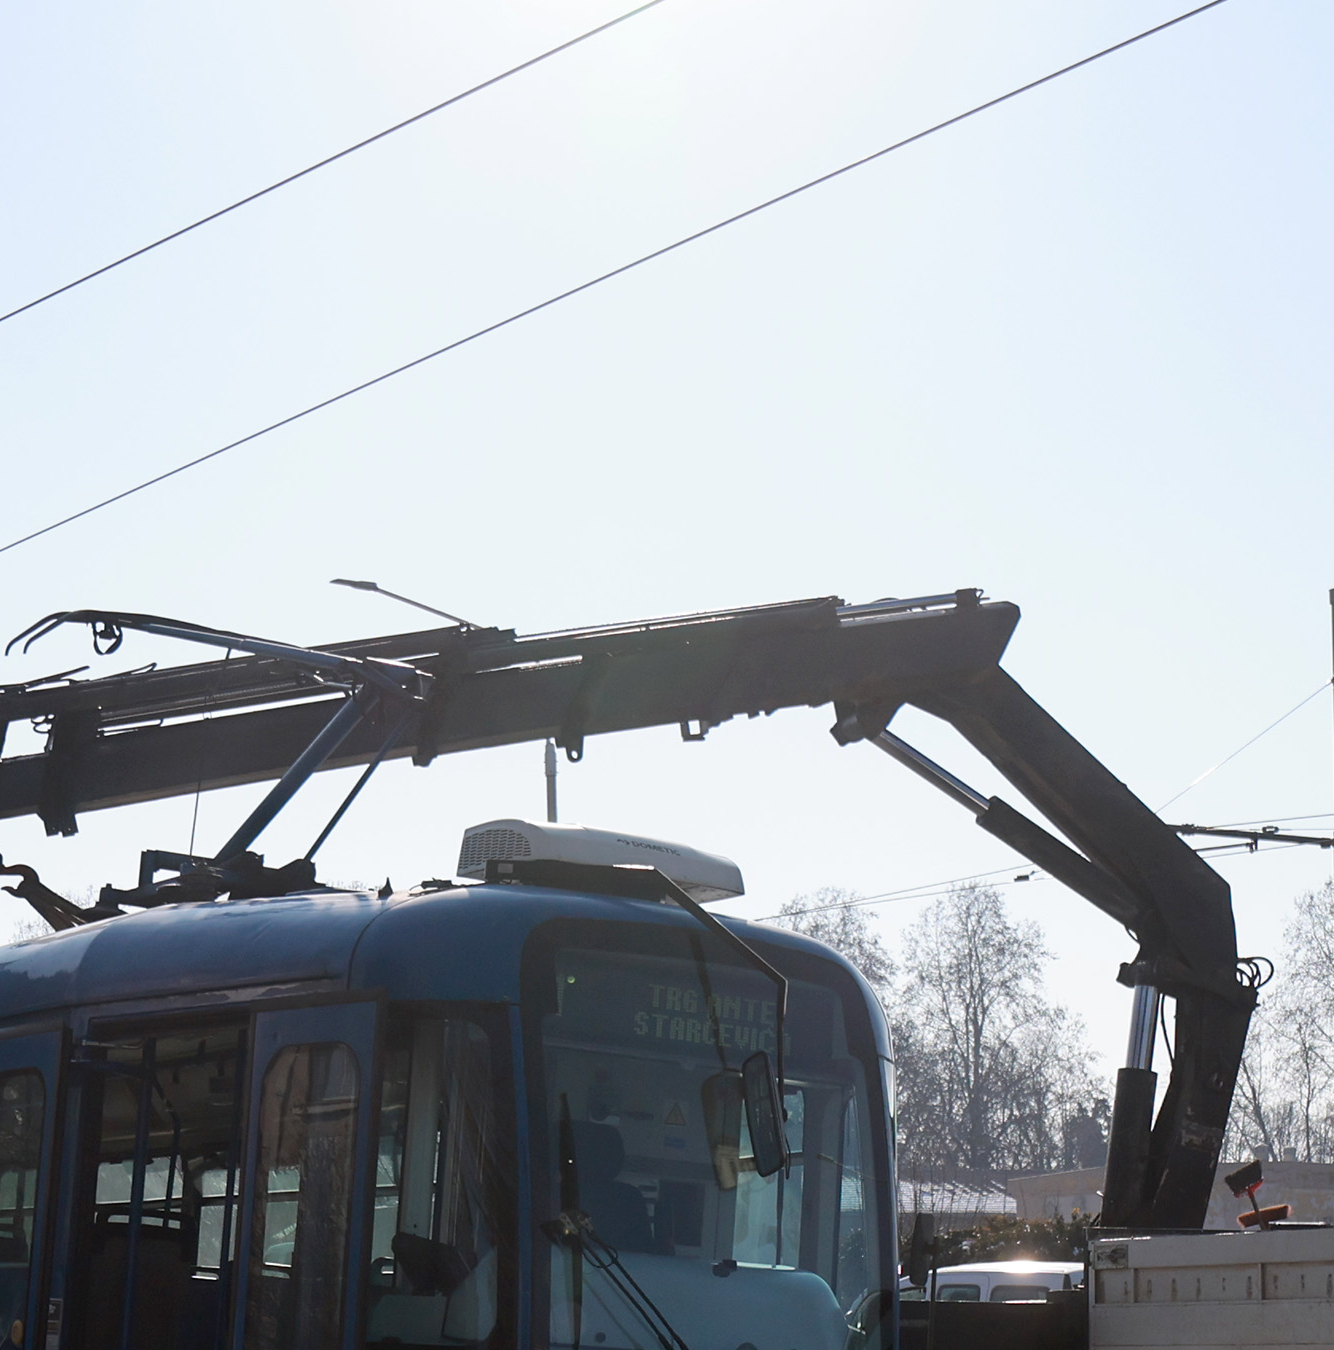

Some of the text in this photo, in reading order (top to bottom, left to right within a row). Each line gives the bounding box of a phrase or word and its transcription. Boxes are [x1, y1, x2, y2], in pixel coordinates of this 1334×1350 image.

[631, 841, 681, 856] DOMETIC
[649, 983, 777, 1026] TRG ANTE
